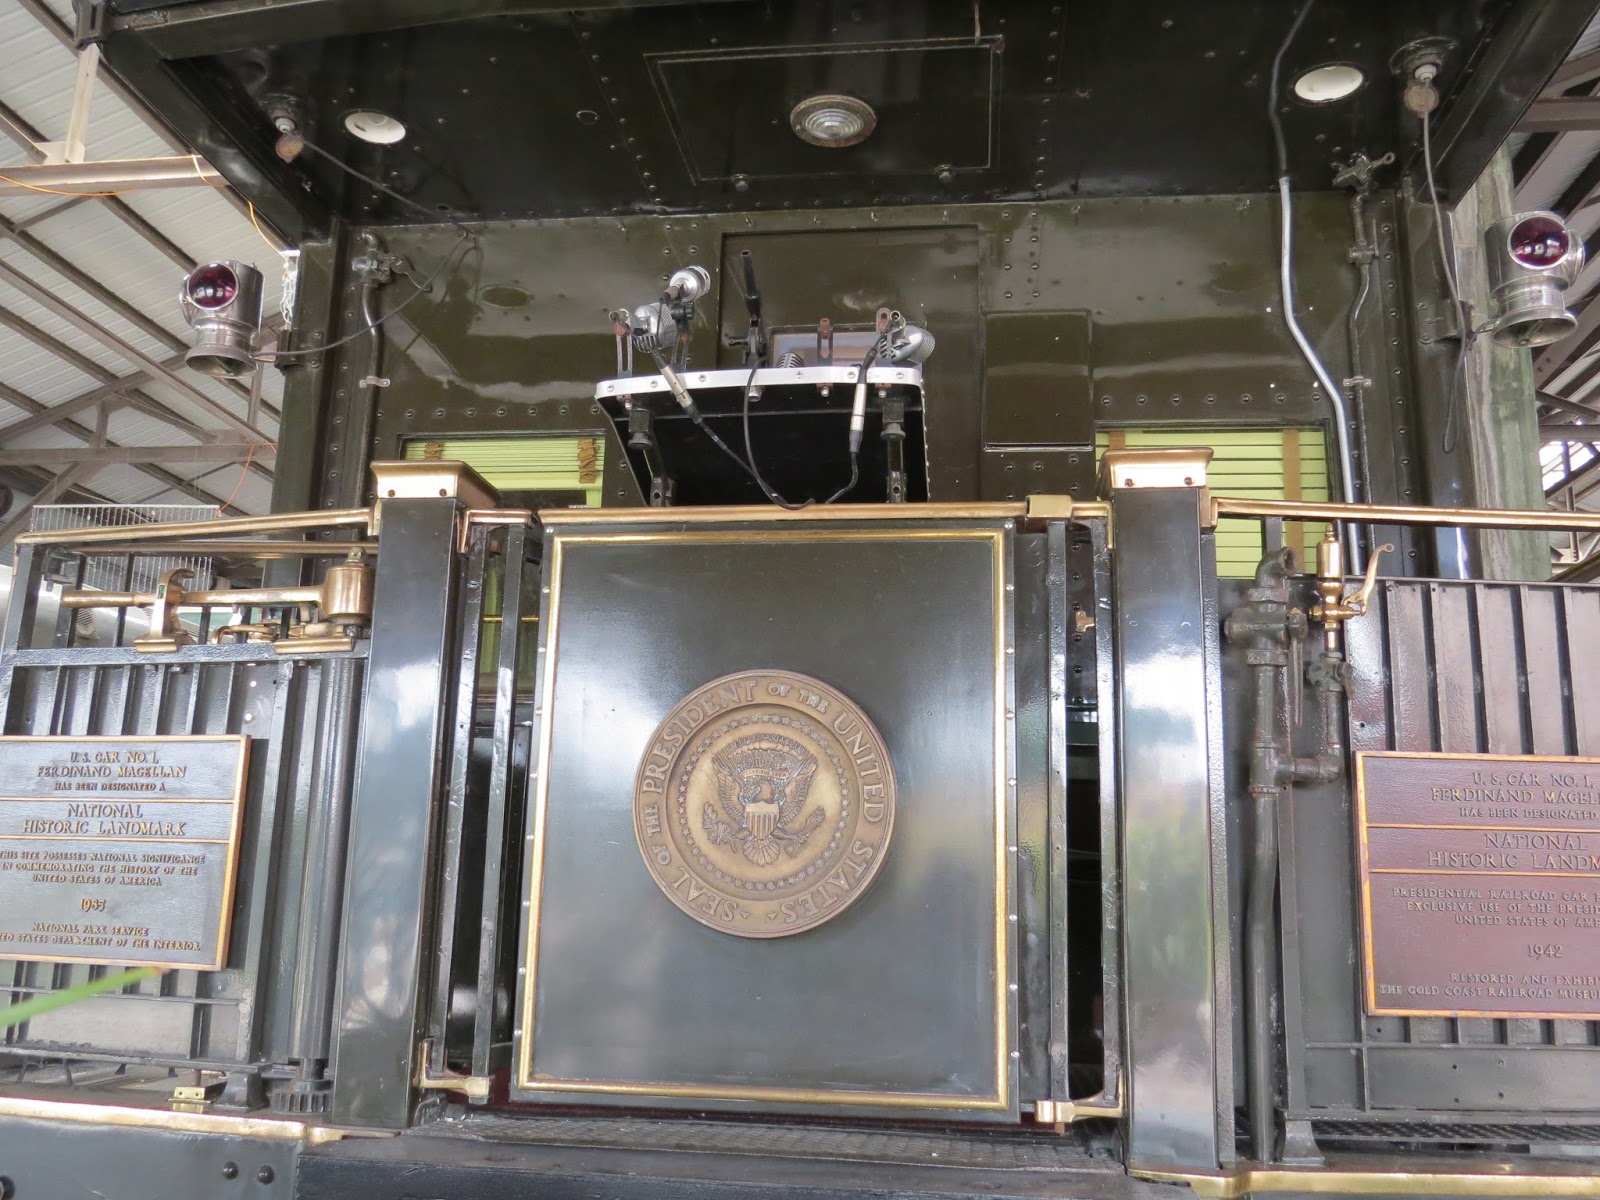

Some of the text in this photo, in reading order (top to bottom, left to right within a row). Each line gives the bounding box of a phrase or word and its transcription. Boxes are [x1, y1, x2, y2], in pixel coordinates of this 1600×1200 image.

[95, 751, 119, 763] CAR
[37, 766, 187, 778] FERDINAND MAGELLAN
[54, 782, 166, 792] HAS BEEN DESIGNATED A
[1507, 773, 1542, 787] CAR
[642, 679, 885, 924] SEAL OF THE PRESIDENT OF THE UNITED STATES
[1431, 787, 1600, 805] FERDINAND MAGEL
[67, 803, 144, 818] NATIONAL
[1459, 807, 1597, 821] HAS BEEN DESIGNATED
[23, 820, 187, 836] HISTORIC LANDMARK
[1484, 832, 1588, 851] NATIONAL
[0, 851, 206, 865] THIS SITE POSSESSES NATIONAL SIGNIFICANCE
[1427, 851, 1519, 869] HISTORIC
[2, 862, 198, 877] IN COMMEMORATING THE HISTORY OF THE
[33, 874, 162, 886] UNITED STATES OF AMERICA
[1392, 887, 1482, 899] PRESIDENTIAL
[1489, 889, 1556, 901] RAILROAD
[1562, 891, 1588, 902] CAR
[80, 898, 107, 913] 1985
[1406, 902, 1473, 913] EXCLUSIVE
[1480, 902, 1500, 913] USE
[1508, 903, 1522, 914] OF
[1528, 904, 1552, 914] THE
[1455, 915, 1501, 926] UNITED
[1506, 916, 1549, 927] STATES
[1554, 917, 1569, 928] OF
[32, 922, 149, 937] NATIONAL PARK SERVICE
[18, 933, 48, 944] STATES
[116, 937, 128, 948] OF
[131, 938, 149, 948] THE
[1528, 944, 1563, 960] 1942
[1450, 973, 1600, 986] RESTORED AND EXHIBI
[1379, 984, 1600, 1000] THE GOLD COAST RAILROAD MUSEU
